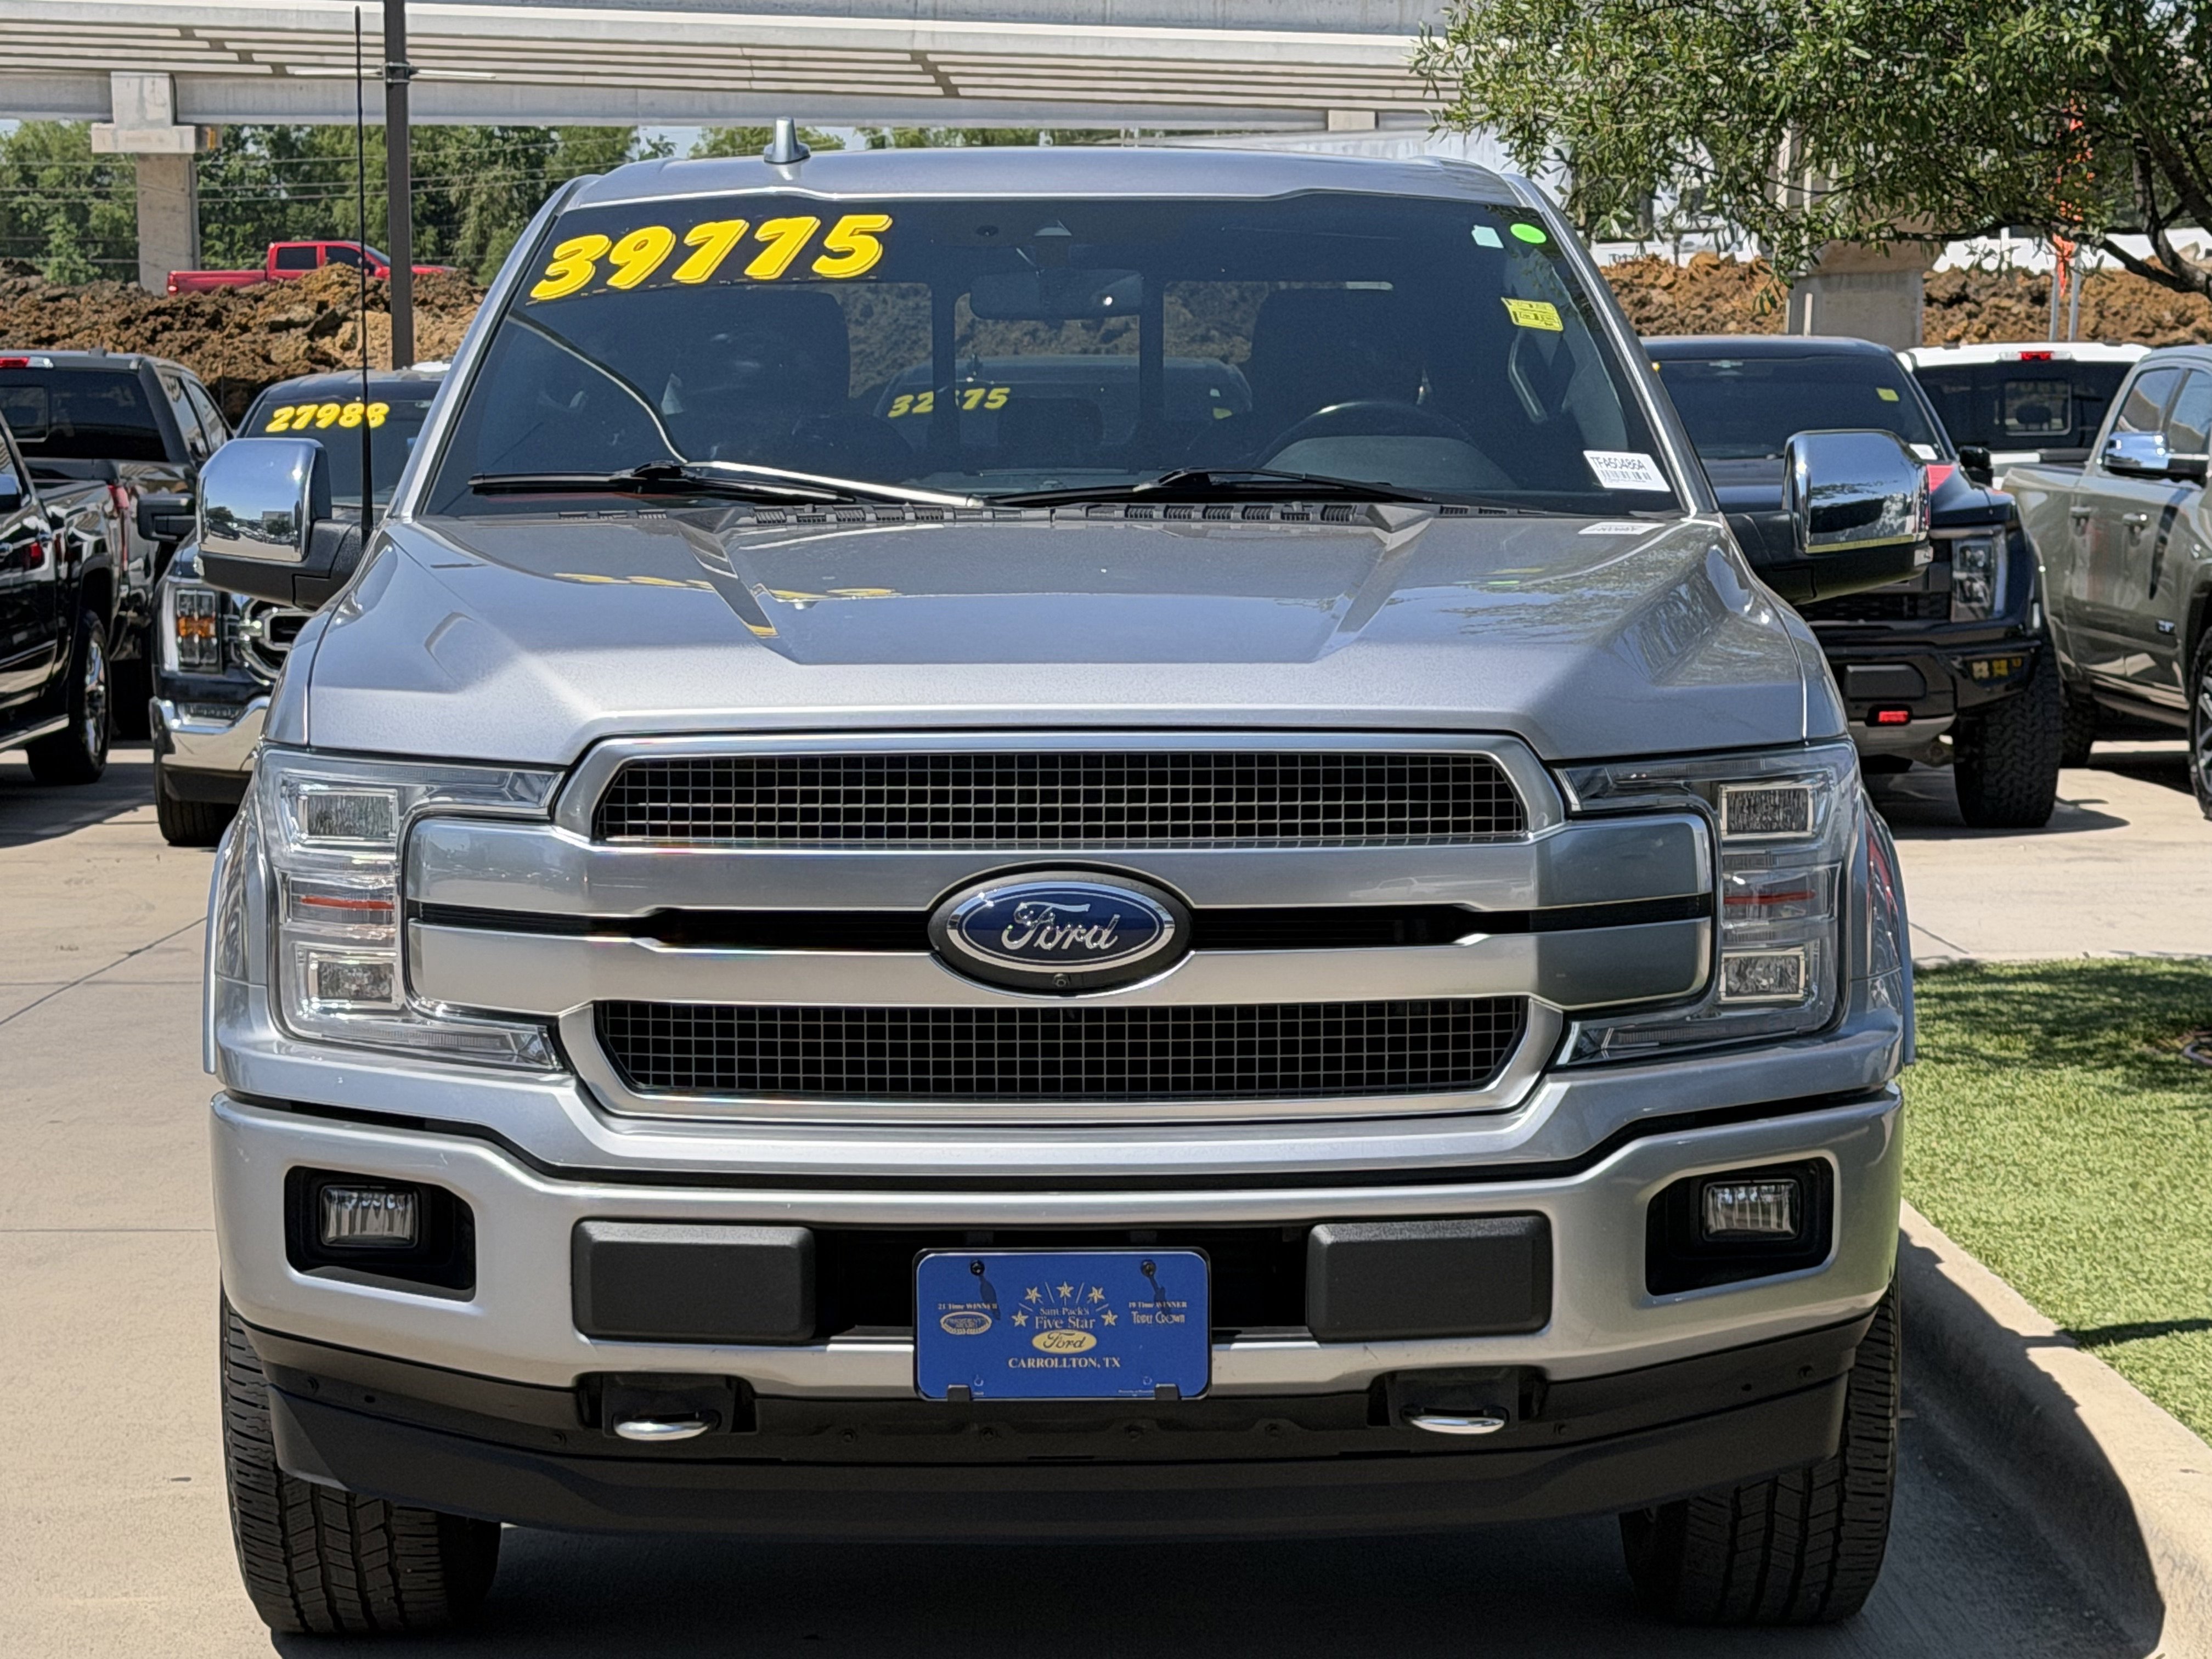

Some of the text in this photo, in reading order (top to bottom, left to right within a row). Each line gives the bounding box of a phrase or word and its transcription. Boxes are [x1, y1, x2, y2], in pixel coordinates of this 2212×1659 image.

[530, 215, 893, 301] 39775
[265, 402, 390, 433] 27988
[887, 387, 1011, 418] 3275
[1001, 901, 1121, 950] Ford
[1035, 1316, 1096, 1329] Five Star
[1042, 1331, 1086, 1349] Ford
[1008, 1357, 1121, 1369] CARROLLTON, TX
